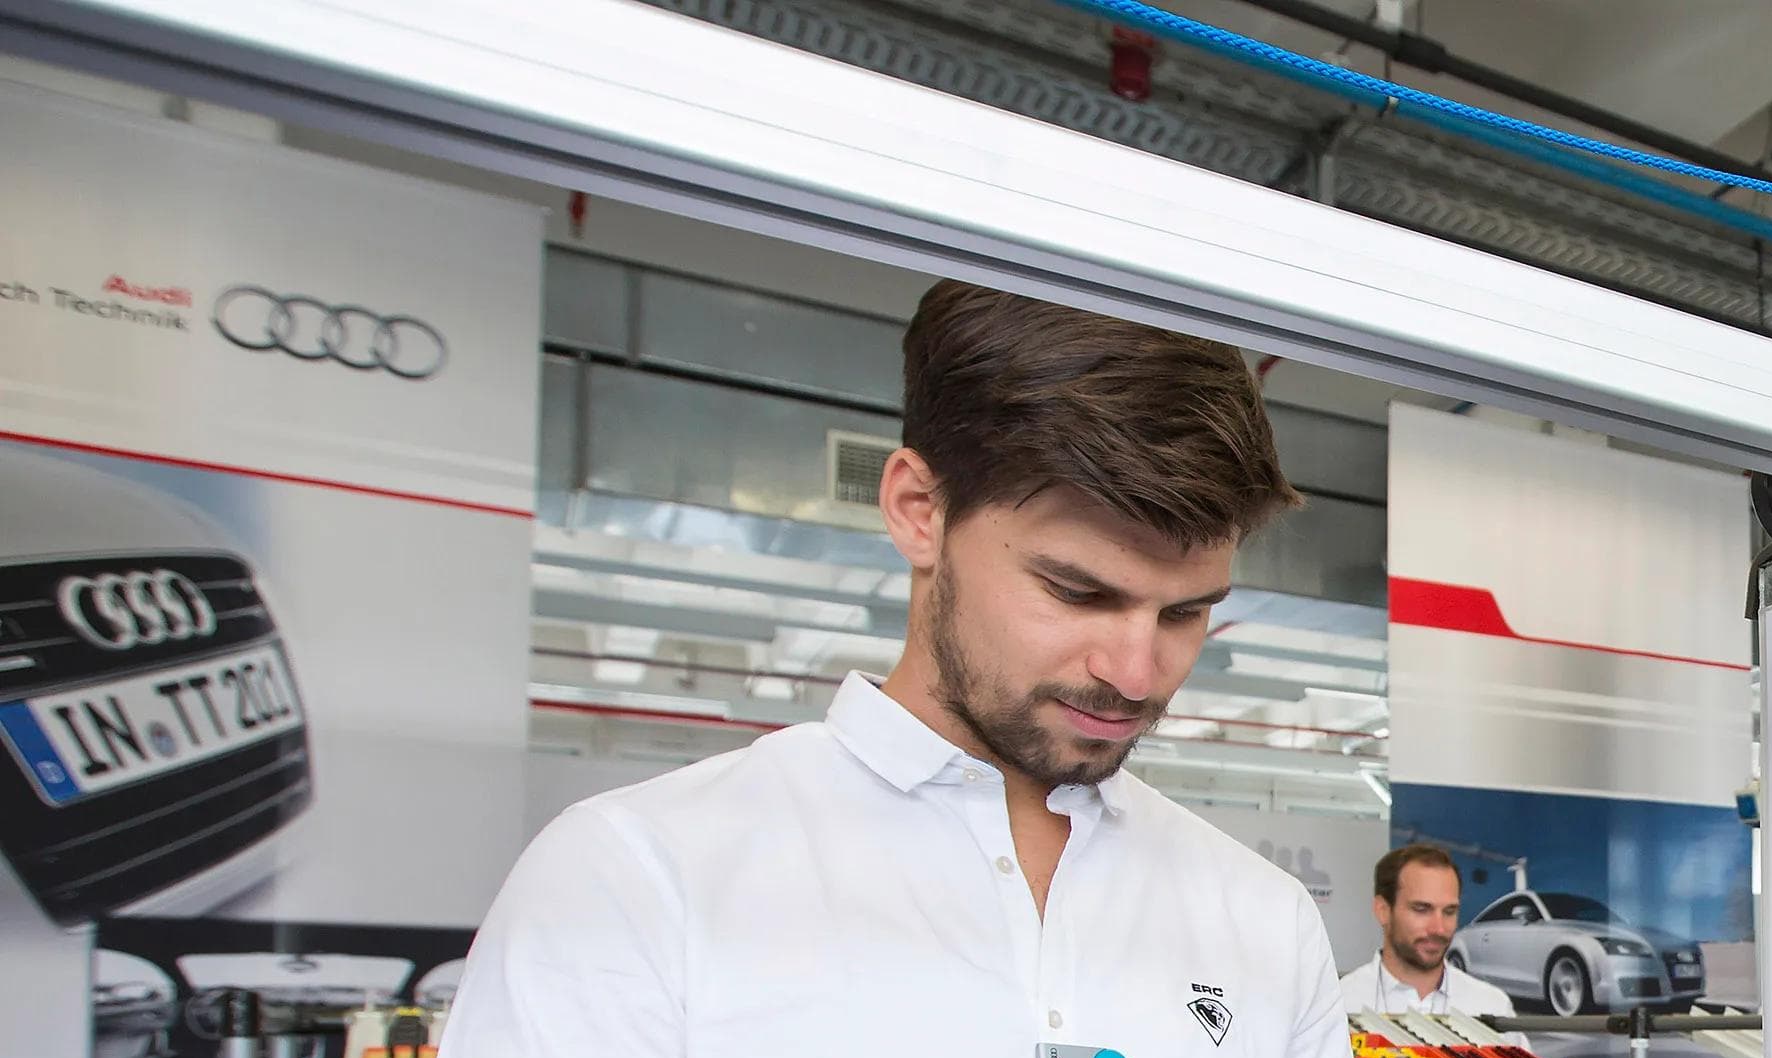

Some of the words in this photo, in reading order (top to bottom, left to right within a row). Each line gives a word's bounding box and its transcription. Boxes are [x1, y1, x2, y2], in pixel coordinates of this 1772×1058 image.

[103, 273, 192, 307] Audi
[48, 286, 190, 331] Technik
[1191, 983, 1224, 997] ERC
